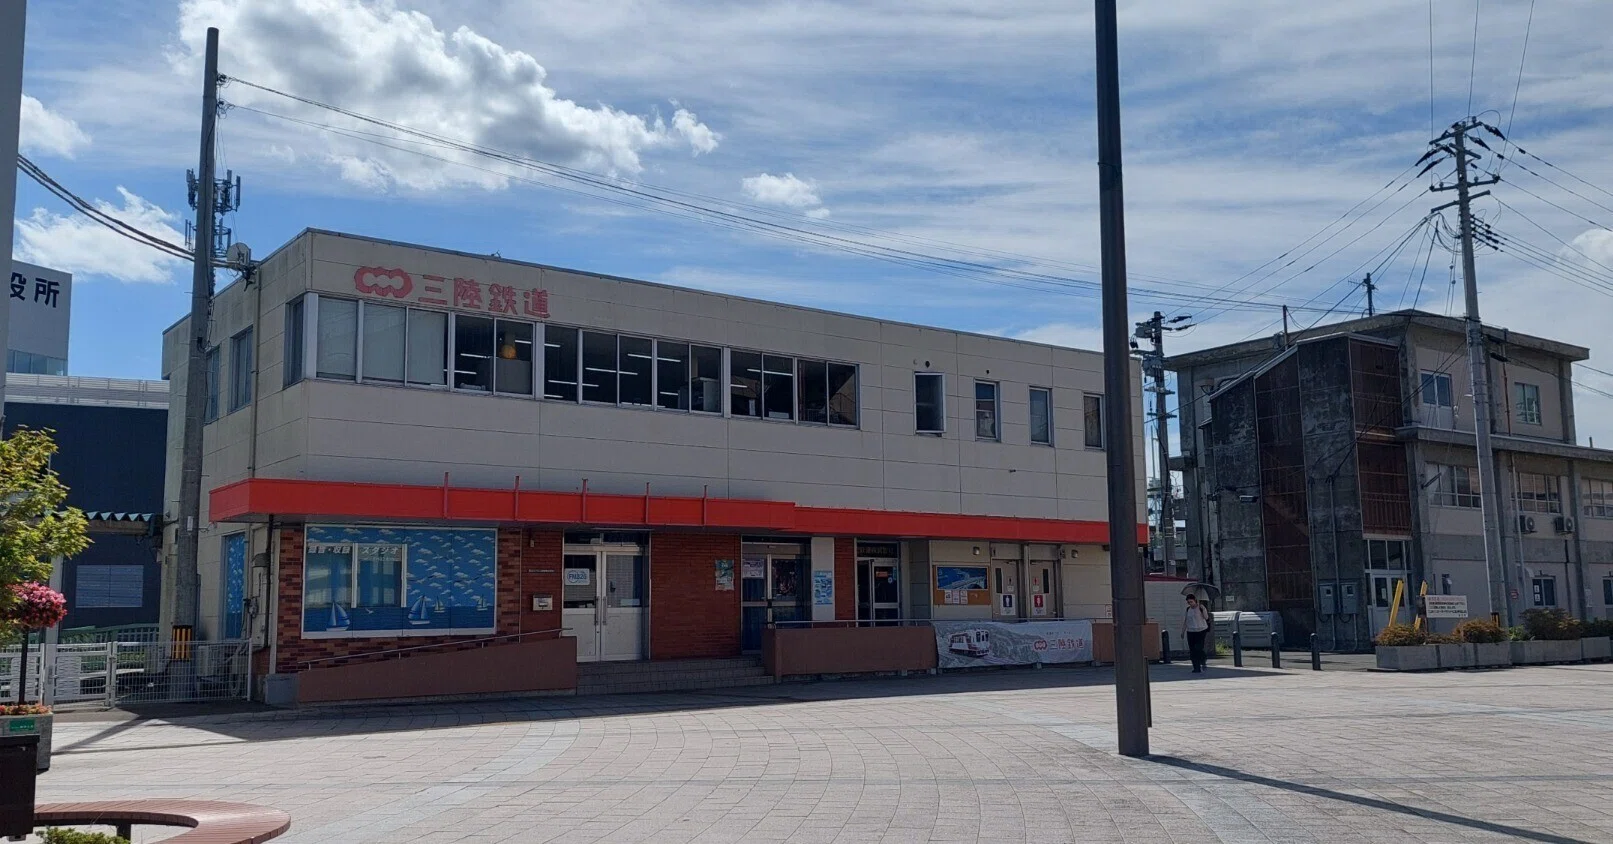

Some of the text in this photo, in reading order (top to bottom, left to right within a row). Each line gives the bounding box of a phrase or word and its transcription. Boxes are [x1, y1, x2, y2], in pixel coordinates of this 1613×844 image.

[418, 274, 551, 318] 三陸鉄道
[362, 546, 399, 556] スタジオ
[1049, 638, 1085, 650] 三陸鉄道
